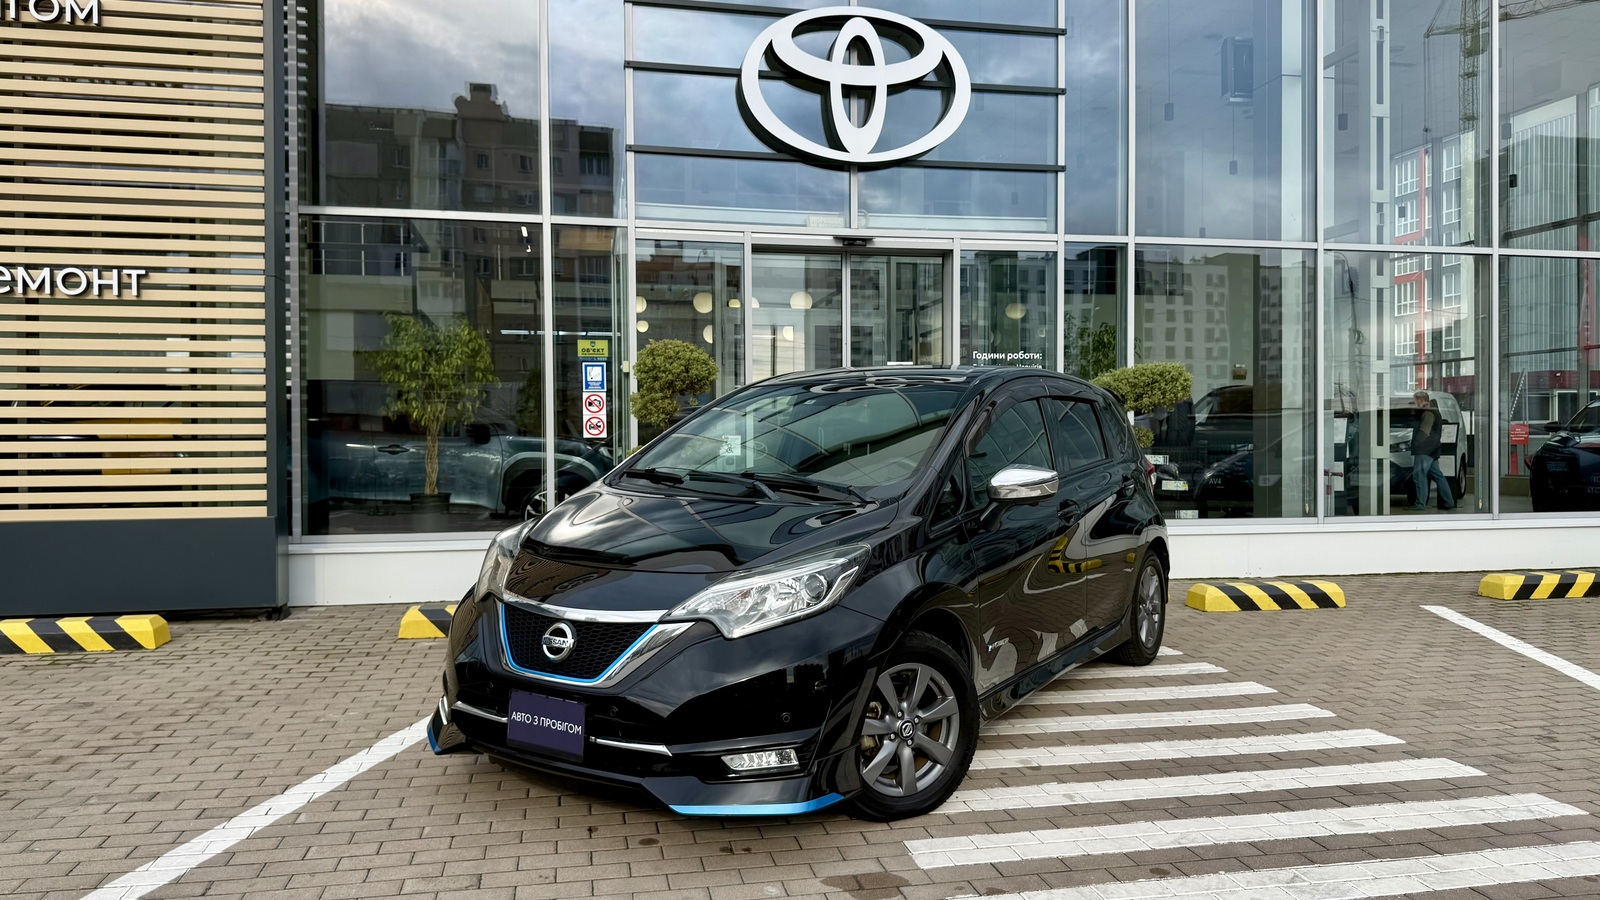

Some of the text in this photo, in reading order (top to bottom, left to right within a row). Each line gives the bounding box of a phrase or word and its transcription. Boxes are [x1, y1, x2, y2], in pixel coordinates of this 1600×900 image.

[972, 350, 1043, 361] Години роботи:
[511, 711, 531, 725] АВТО
[540, 717, 582, 735] ПРОБІГОМ
